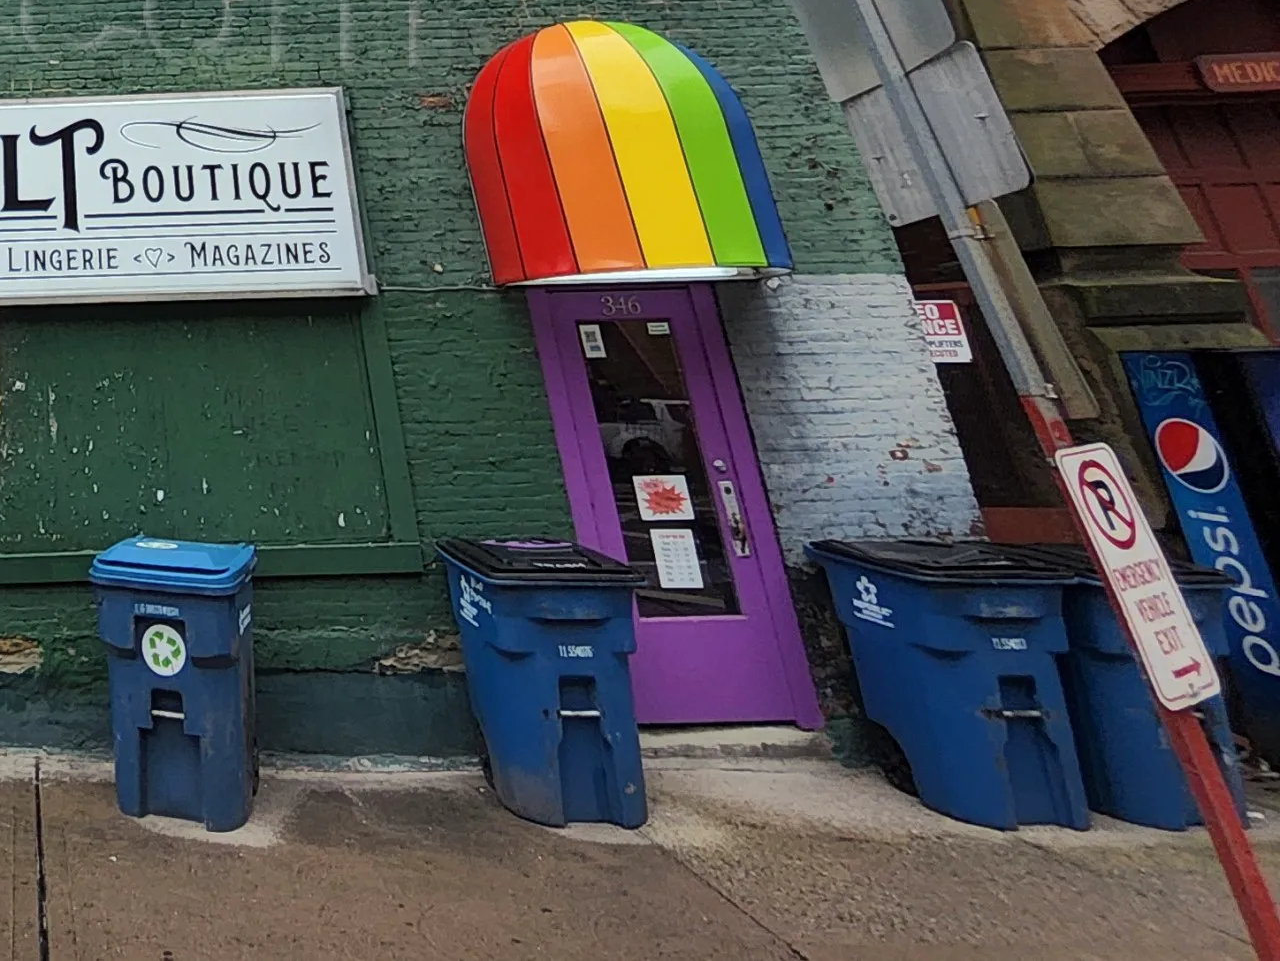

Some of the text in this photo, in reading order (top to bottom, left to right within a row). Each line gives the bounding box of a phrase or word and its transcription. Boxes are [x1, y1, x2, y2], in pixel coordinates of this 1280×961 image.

[99, 158, 333, 212] BOUTIQUE
[7, 247, 120, 273] LINGERIE
[184, 241, 331, 270] MAGAZINES
[600, 295, 642, 316] 346
[1153, 625, 1186, 655] EXIT
